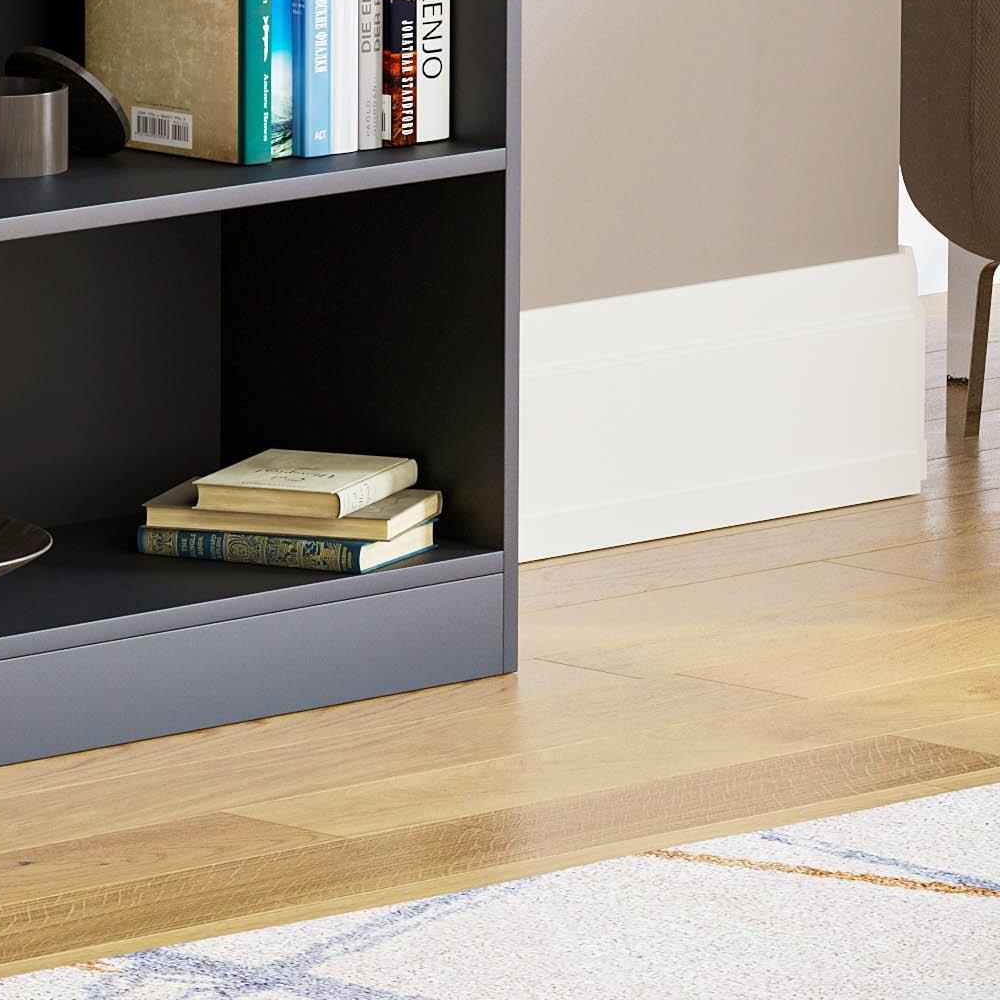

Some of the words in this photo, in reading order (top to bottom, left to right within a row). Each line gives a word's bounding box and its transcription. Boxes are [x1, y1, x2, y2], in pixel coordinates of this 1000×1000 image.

[361, 22, 371, 54] DIE
[374, 13, 382, 52] DER
[401, 20, 413, 73] JONATHAN
[401, 76, 414, 136] STANDFORD
